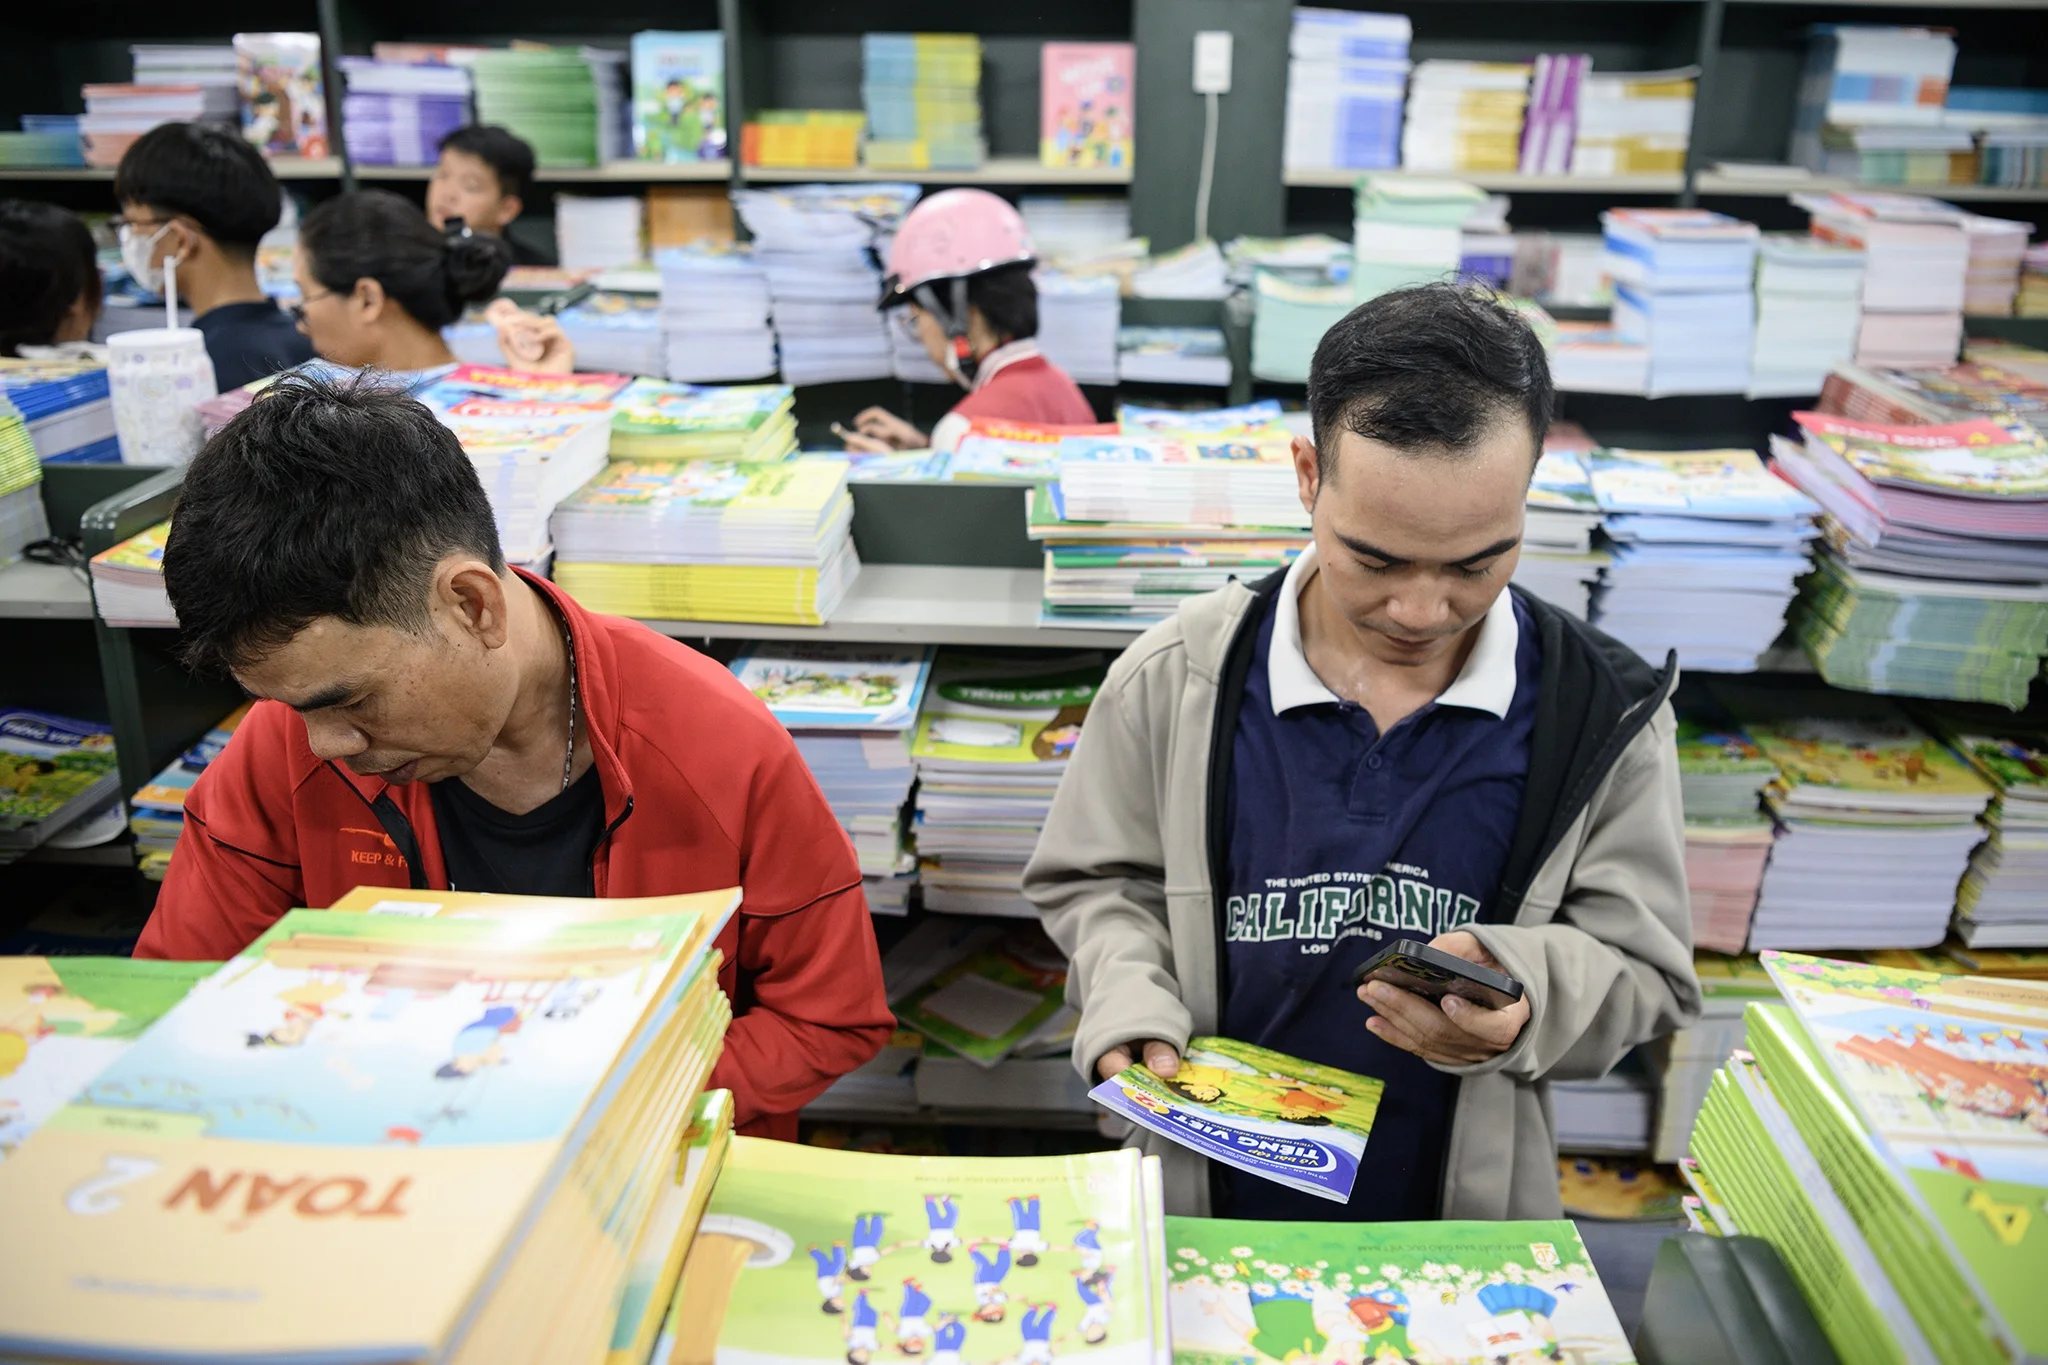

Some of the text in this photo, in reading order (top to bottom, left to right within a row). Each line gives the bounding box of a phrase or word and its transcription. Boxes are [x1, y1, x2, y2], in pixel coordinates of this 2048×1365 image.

[351, 850, 408, 868] KEEP & F
[1265, 877, 1288, 888] THE
[1290, 873, 1331, 887] UNITED
[1384, 862, 1429, 879] MERICA
[1300, 927, 1383, 955] LOS GELES
[1173, 1114, 1230, 1141] VIỆT
[1237, 1136, 1320, 1160] TIẾNG
[65, 1153, 417, 1234] TOÁN 2
[1968, 1188, 2033, 1248] 4
